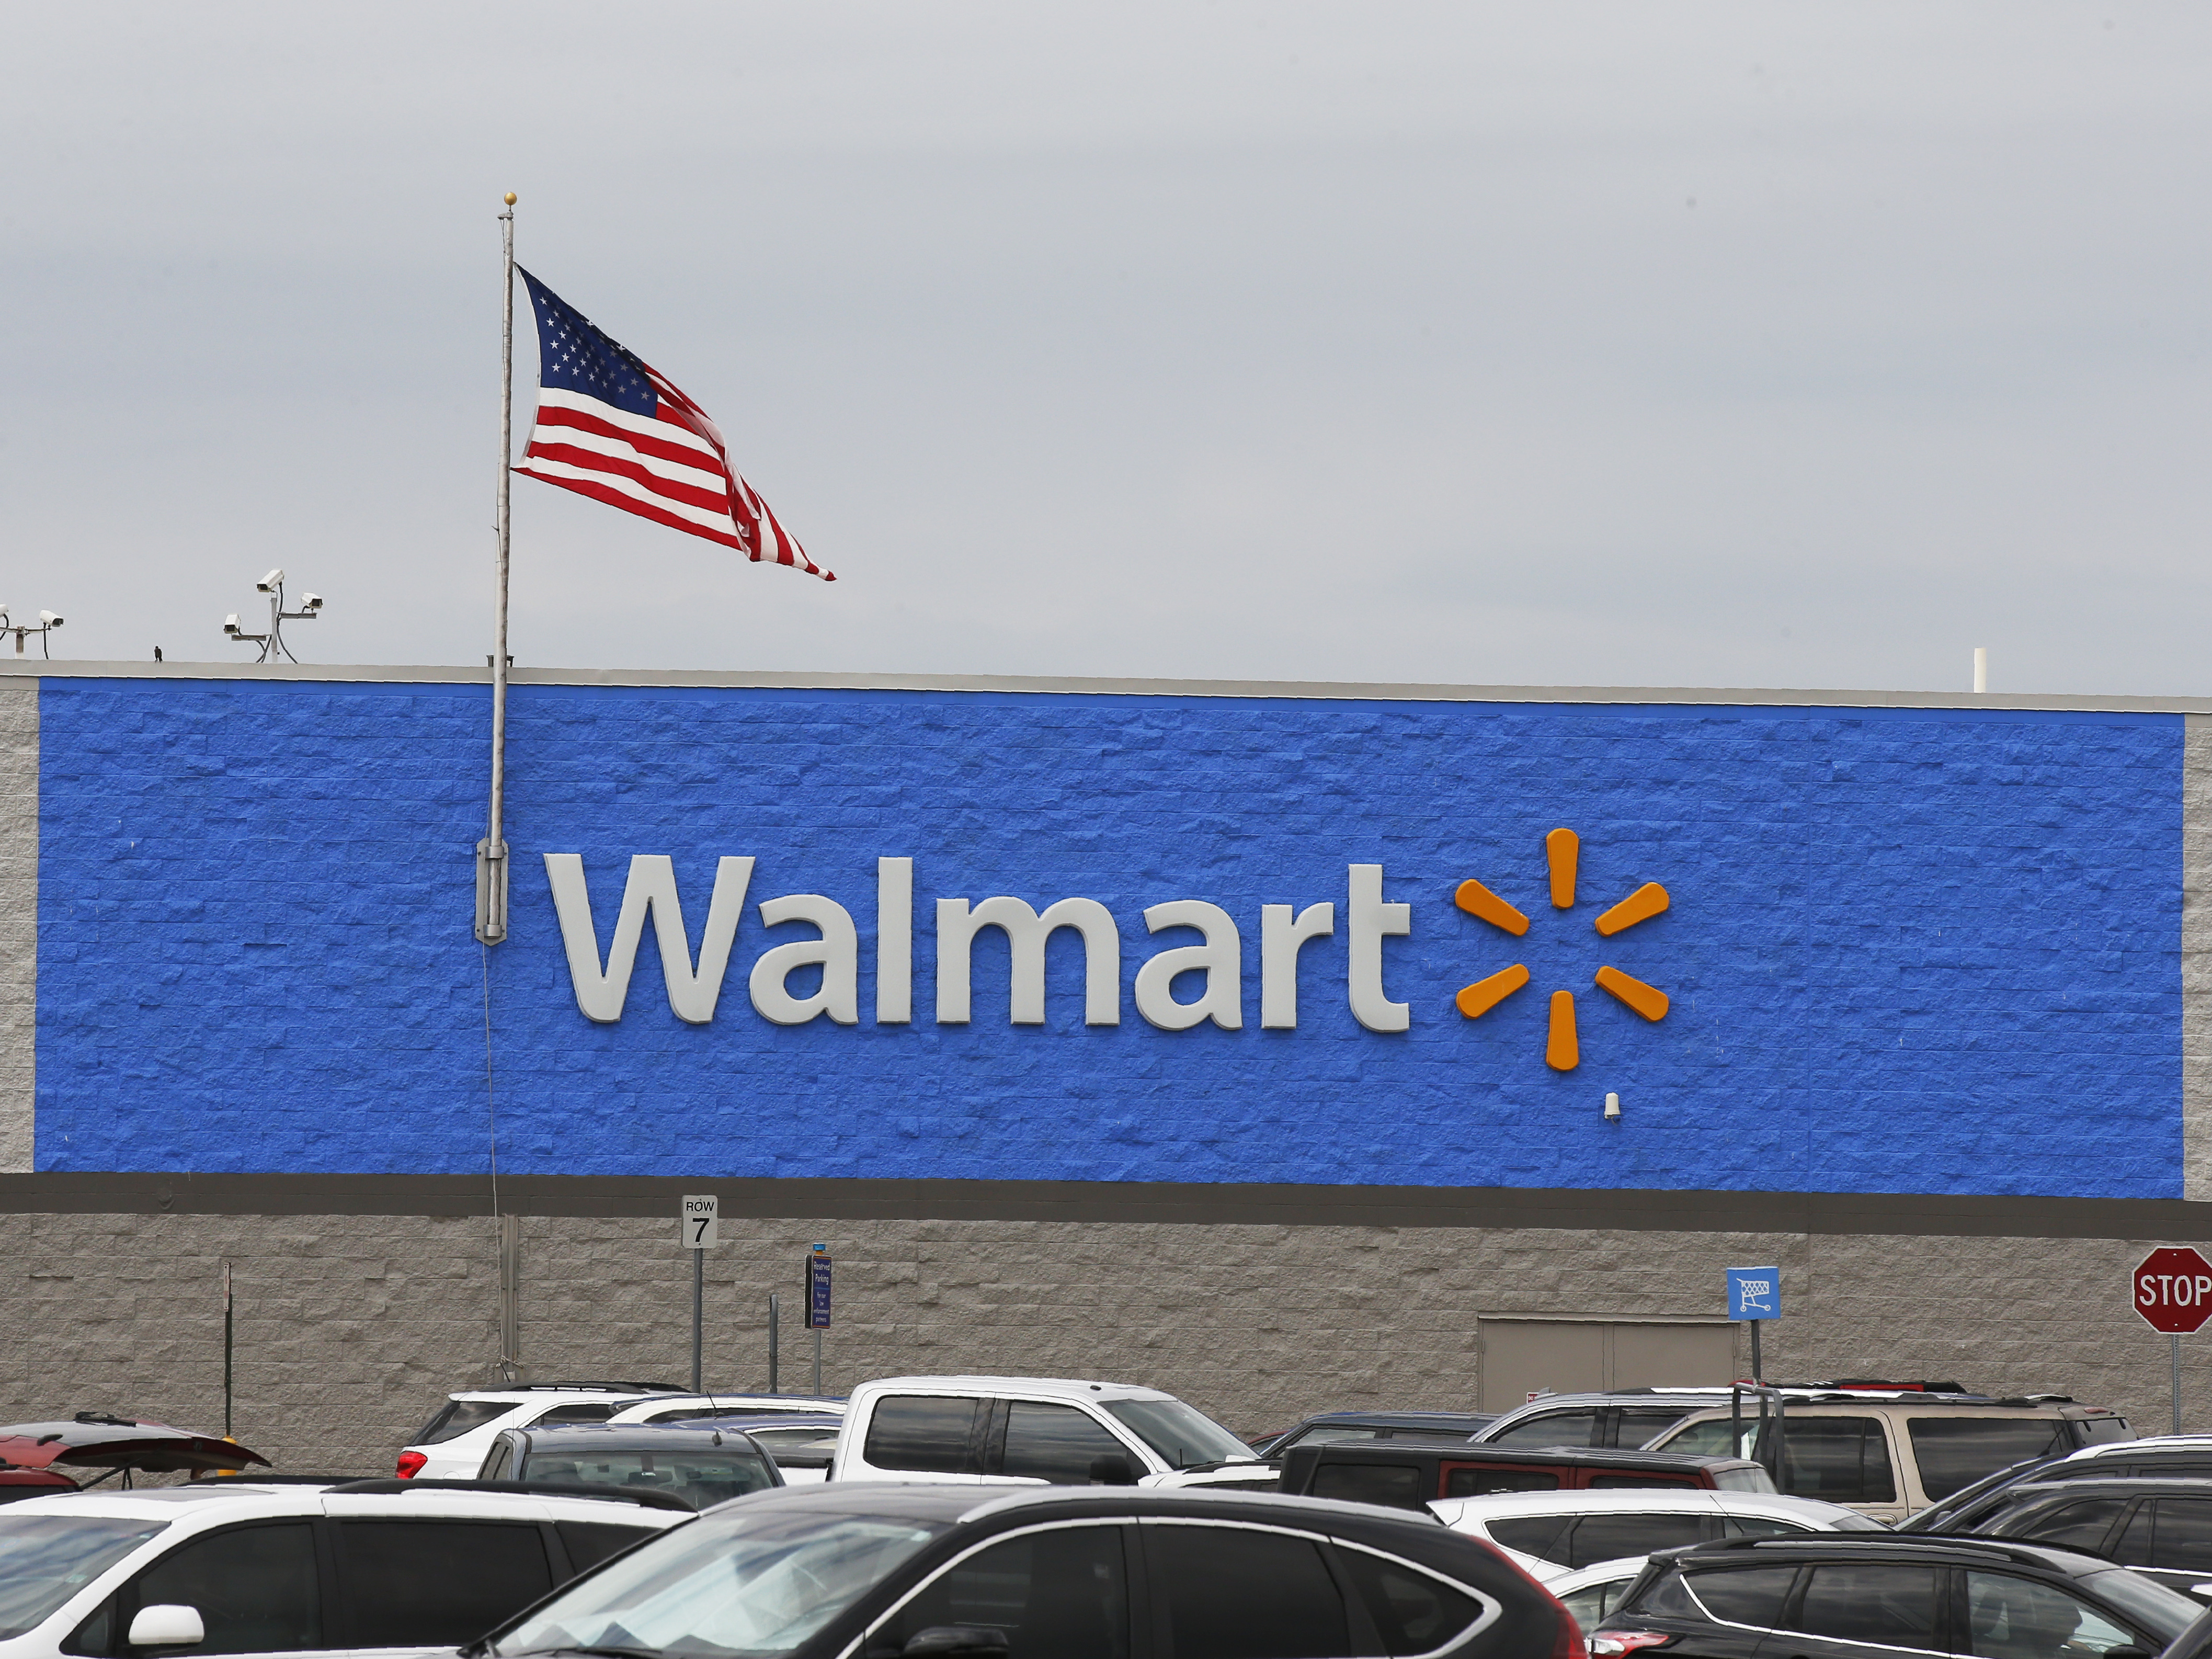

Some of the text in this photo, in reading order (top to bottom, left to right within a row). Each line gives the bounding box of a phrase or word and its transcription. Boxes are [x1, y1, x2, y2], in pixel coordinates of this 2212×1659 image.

[543, 853, 1410, 1032] Walmart
[686, 1201, 714, 1212] ROW
[692, 1218, 710, 1242] 7
[814, 1261, 830, 1271] Reserved
[815, 1274, 829, 1286] Parking
[2139, 1275, 2212, 1306] STOP
